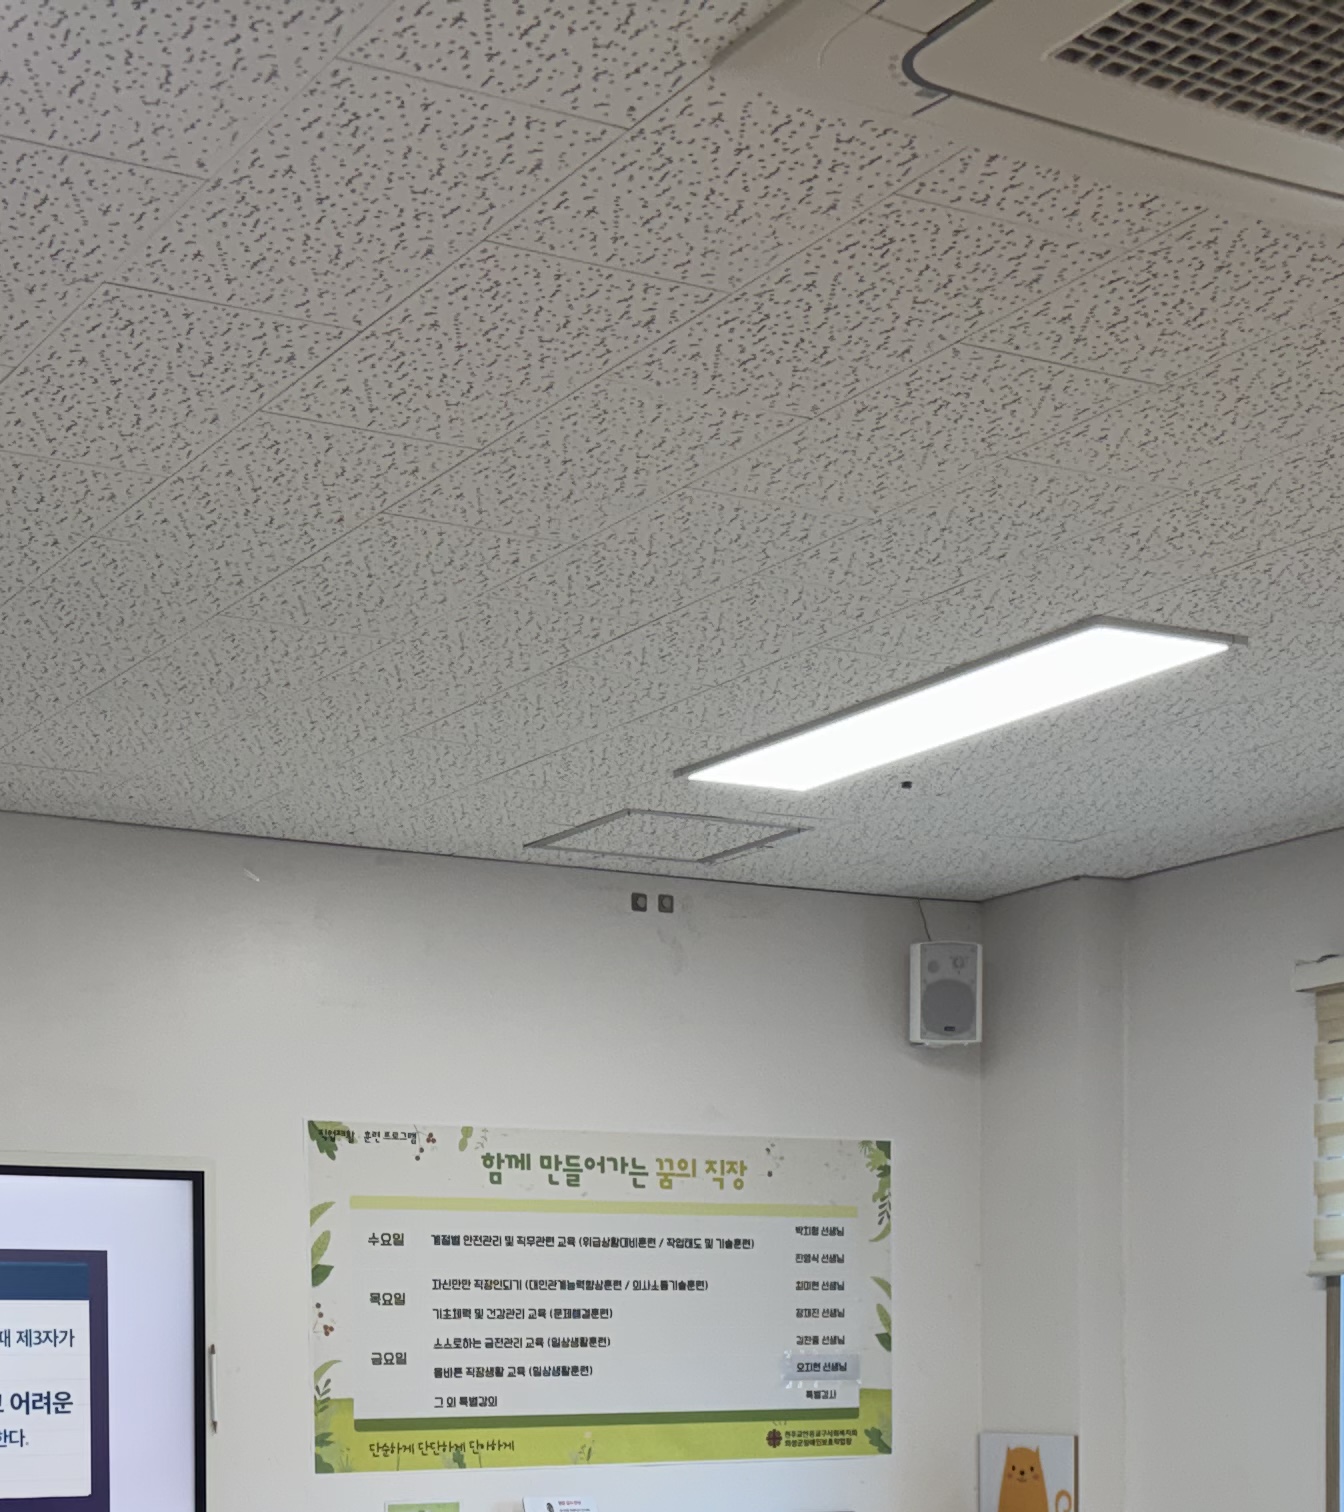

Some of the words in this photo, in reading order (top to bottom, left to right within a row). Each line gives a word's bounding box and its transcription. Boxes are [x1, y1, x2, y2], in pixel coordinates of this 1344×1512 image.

[364, 1130, 381, 1144] 훈련
[383, 1130, 417, 1145] 프로그램
[481, 1152, 531, 1185] 함께
[539, 1153, 649, 1189] 만들어가는
[655, 1157, 697, 1190] 꿈의
[704, 1159, 748, 1191] 직장
[821, 1226, 845, 1237] 선생님
[367, 1232, 405, 1247] 수요일
[463, 1235, 502, 1247] 안전관리
[505, 1235, 514, 1247] 및
[557, 1236, 576, 1248] 교육
[821, 1253, 845, 1264] 선생님
[821, 1280, 845, 1291] 선생님
[369, 1292, 406, 1306] 목요일
[487, 1308, 525, 1320] 건강관리
[528, 1308, 547, 1320] 교육
[821, 1307, 845, 1318] 선생님
[16, 1327, 76, 1348] 제3자가
[433, 1337, 482, 1349] 스스로하는
[484, 1337, 523, 1349] 금전관리
[525, 1337, 544, 1349] 교육
[821, 1335, 845, 1345] 선생님
[370, 1352, 407, 1366] 금요일
[507, 1366, 526, 1377] 교육
[822, 1362, 847, 1372] 선생님
[9, 1390, 74, 1415] 어려운
[434, 1396, 444, 1408] 그
[369, 1440, 415, 1458] 단순하게
[417, 1440, 466, 1457] 단단하게
[469, 1439, 515, 1455] 단아하게
